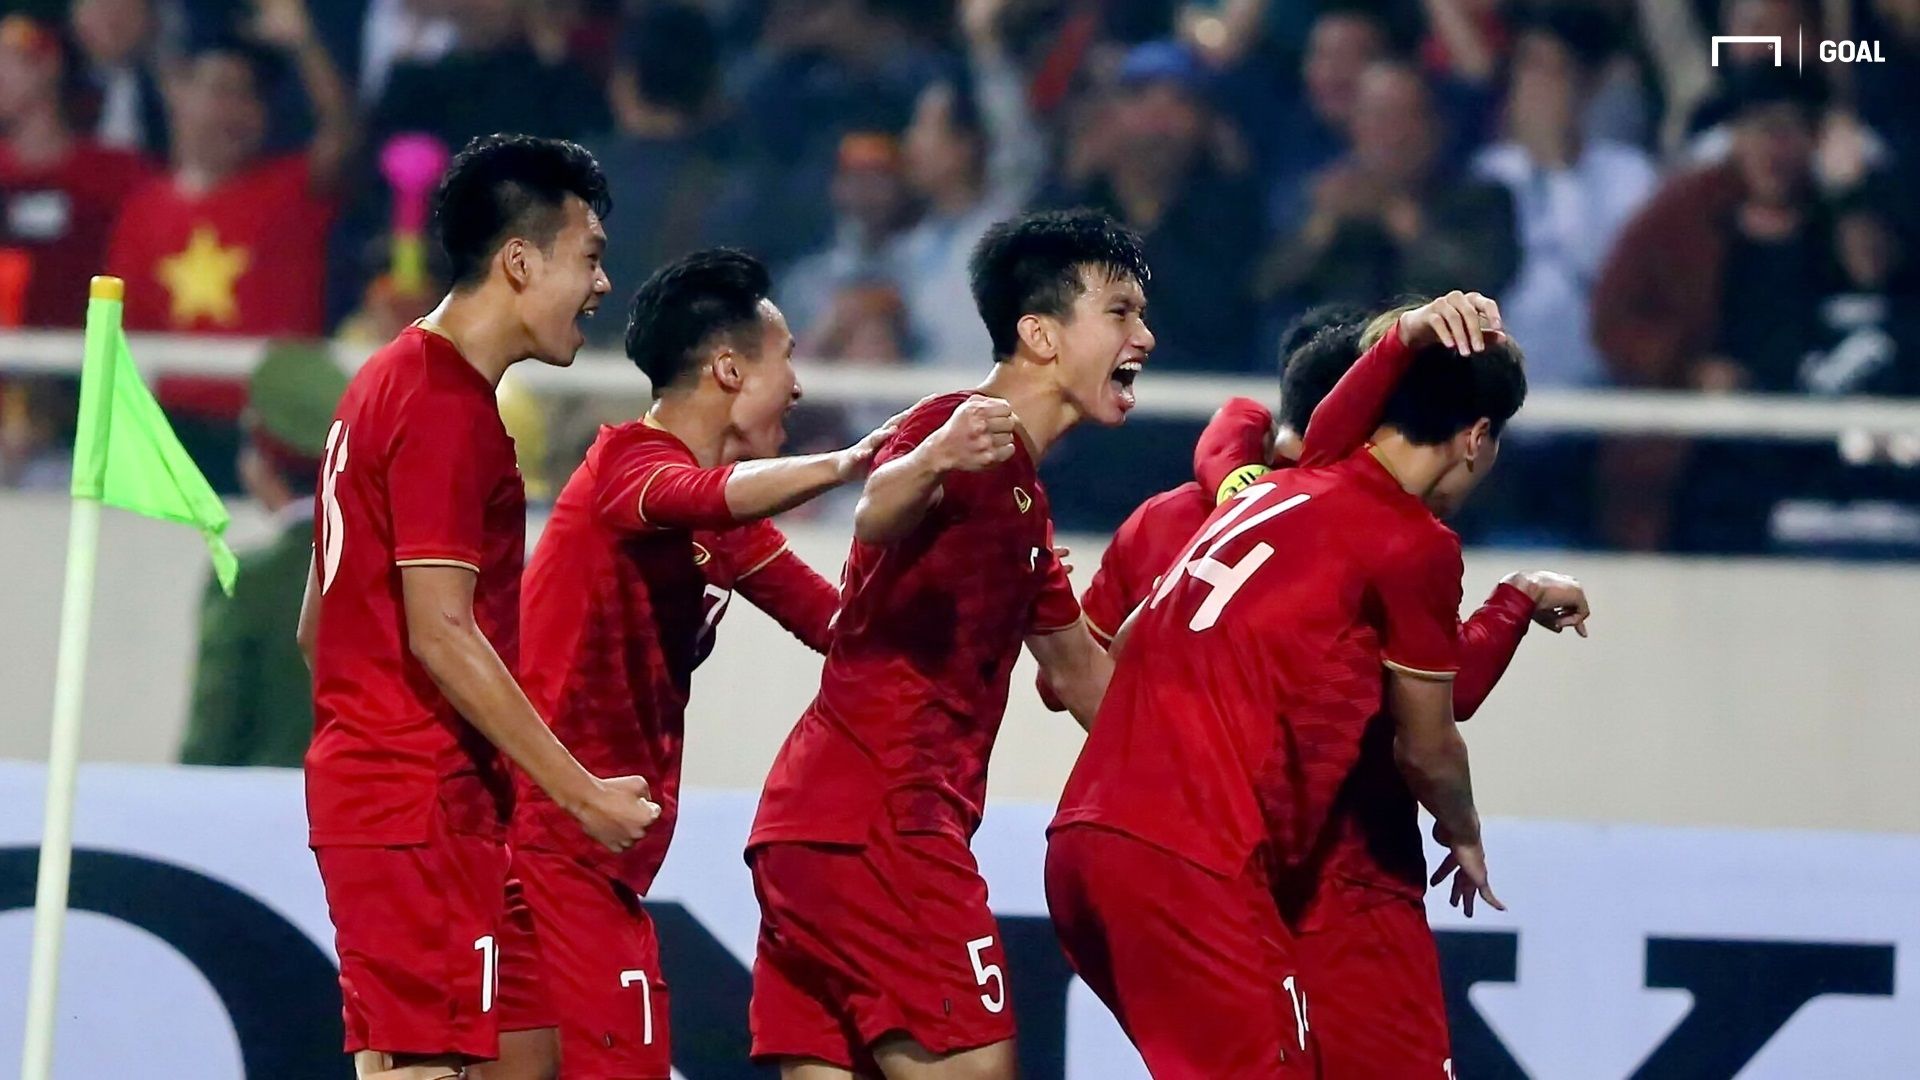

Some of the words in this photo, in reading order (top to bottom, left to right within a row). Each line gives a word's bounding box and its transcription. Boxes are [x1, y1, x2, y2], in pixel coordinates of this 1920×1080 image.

[1150, 481, 1311, 632] 14
[474, 935, 499, 1013] 1
[620, 969, 653, 1045] 7
[966, 935, 1005, 1013] 5
